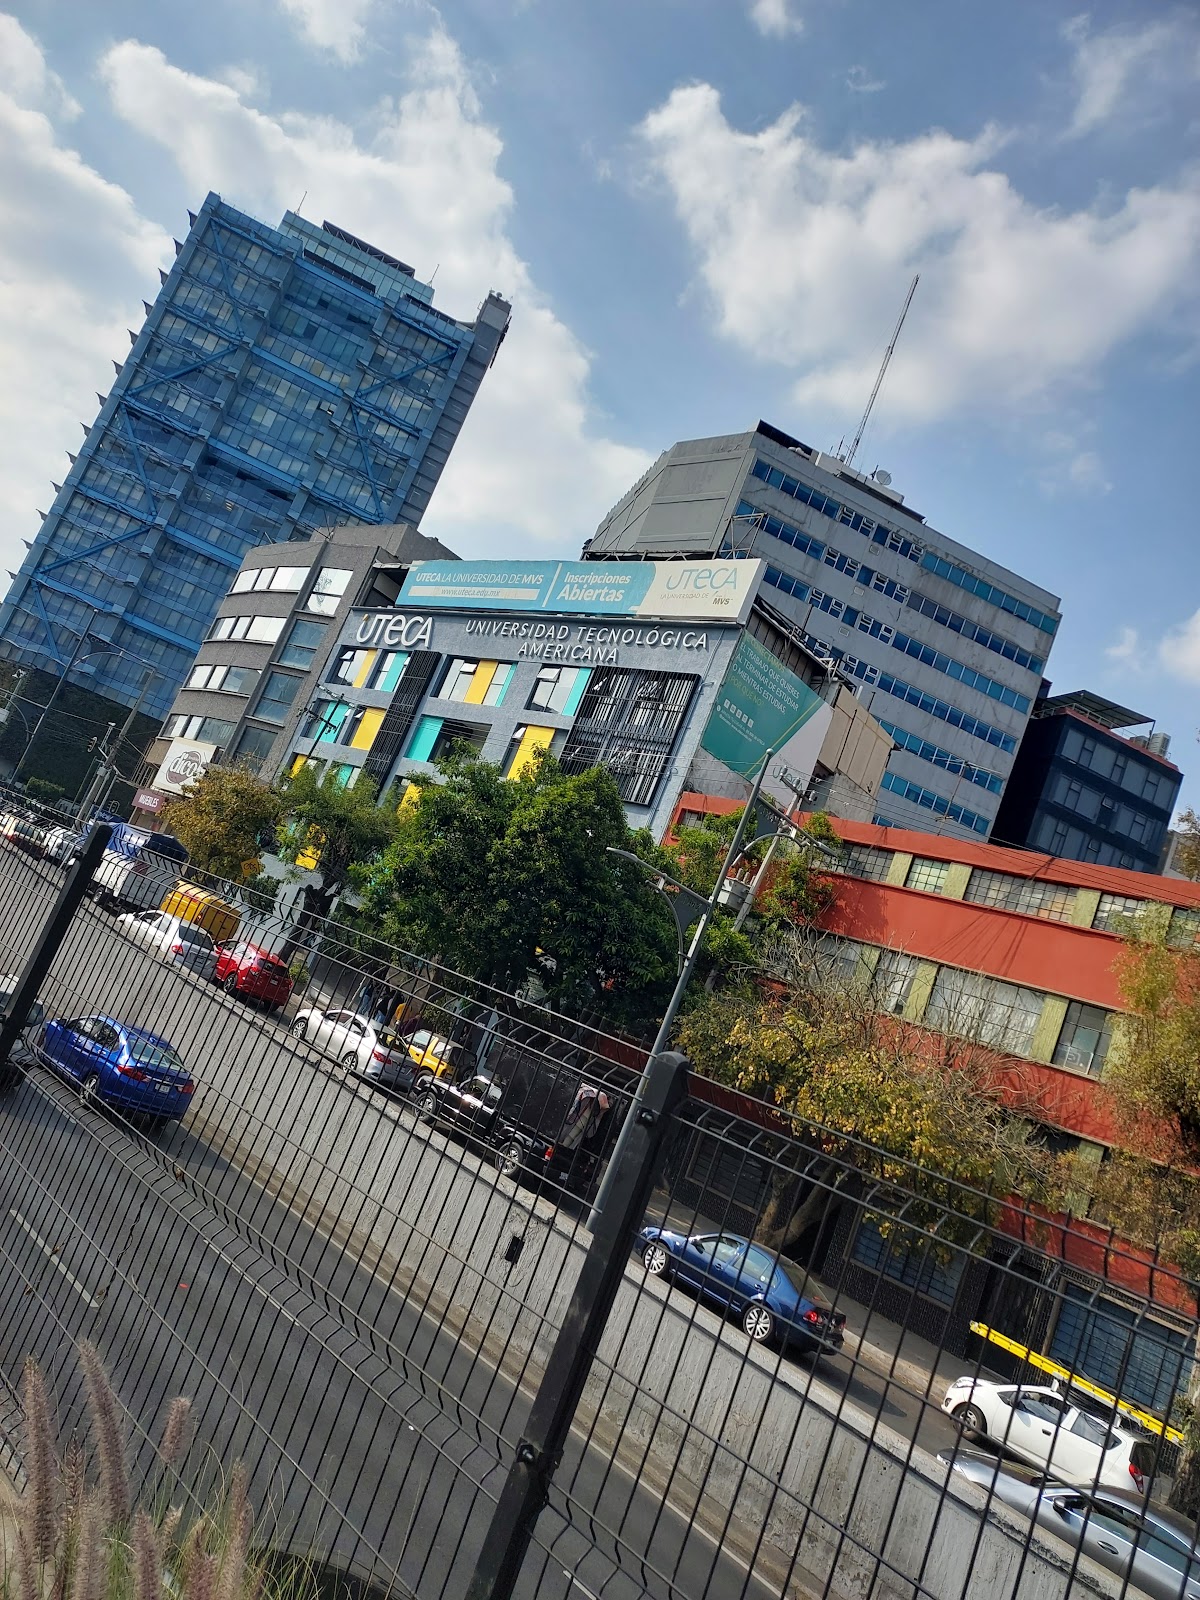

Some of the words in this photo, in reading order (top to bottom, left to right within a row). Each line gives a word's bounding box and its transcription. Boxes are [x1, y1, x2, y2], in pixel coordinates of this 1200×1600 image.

[416, 572, 442, 583] UTECA
[441, 573, 452, 582] LA
[452, 573, 508, 584] UNIVERSIDAD
[509, 574, 522, 584] DE
[522, 574, 544, 584] MVS
[564, 572, 632, 585] Inscripciones
[441, 588, 500, 598] www.uteca.edu.mx
[556, 584, 624, 602] Abiertas
[465, 619, 570, 641] UNIVERSIDAD
[577, 625, 708, 649] TECNOLÓGICA
[518, 642, 619, 664] AMERICANA
[737, 668, 763, 694] MIENTRAS
[744, 658, 768, 686] TERMINAR
[776, 688, 798, 711] ESTUDIAR
[746, 648, 768, 672] TRABAJO
[768, 669, 780, 682] QUE
[780, 678, 800, 699] QUIERES
